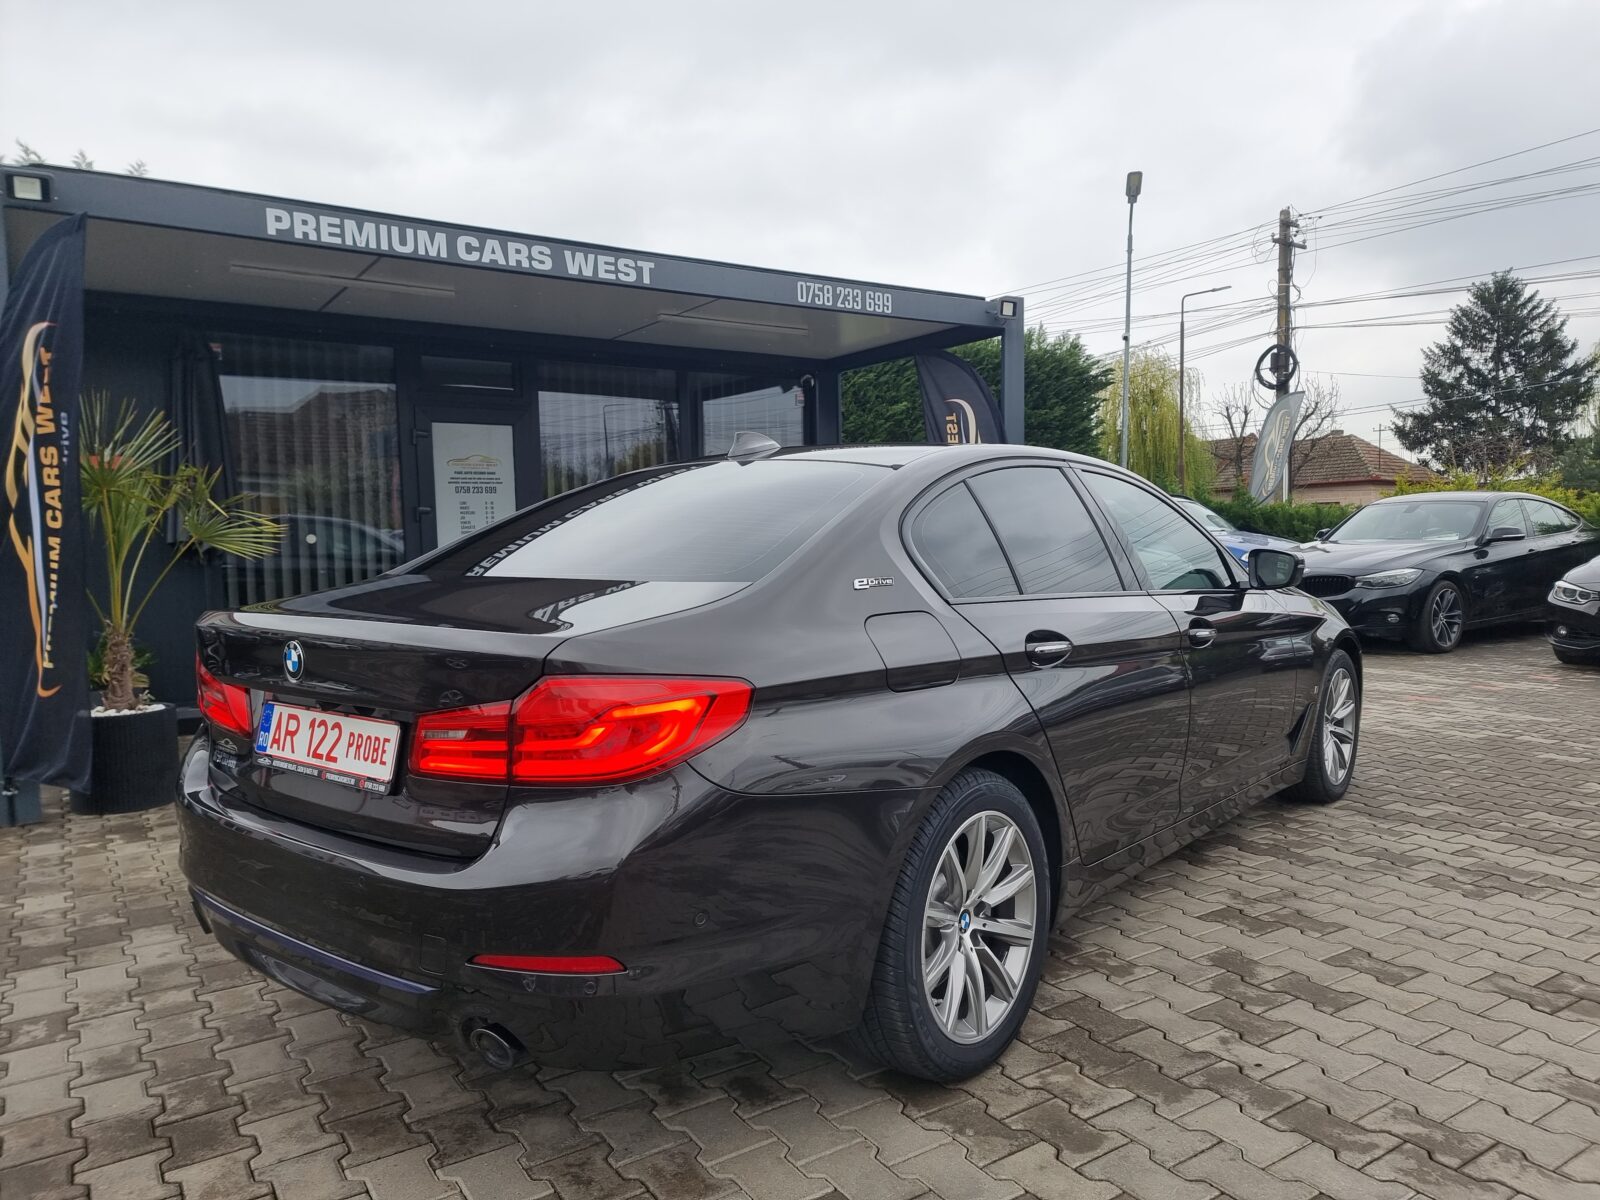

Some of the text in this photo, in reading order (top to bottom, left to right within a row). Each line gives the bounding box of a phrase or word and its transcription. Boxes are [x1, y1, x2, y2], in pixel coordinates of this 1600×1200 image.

[265, 207, 655, 285] PREMIUM CARS WEST
[797, 281, 892, 314] 0758 233 699
[39, 445, 63, 529] CARS
[454, 486, 497, 494] 0758 233 699
[258, 731, 269, 747] RO
[270, 711, 391, 766] AR 122 PROBE
